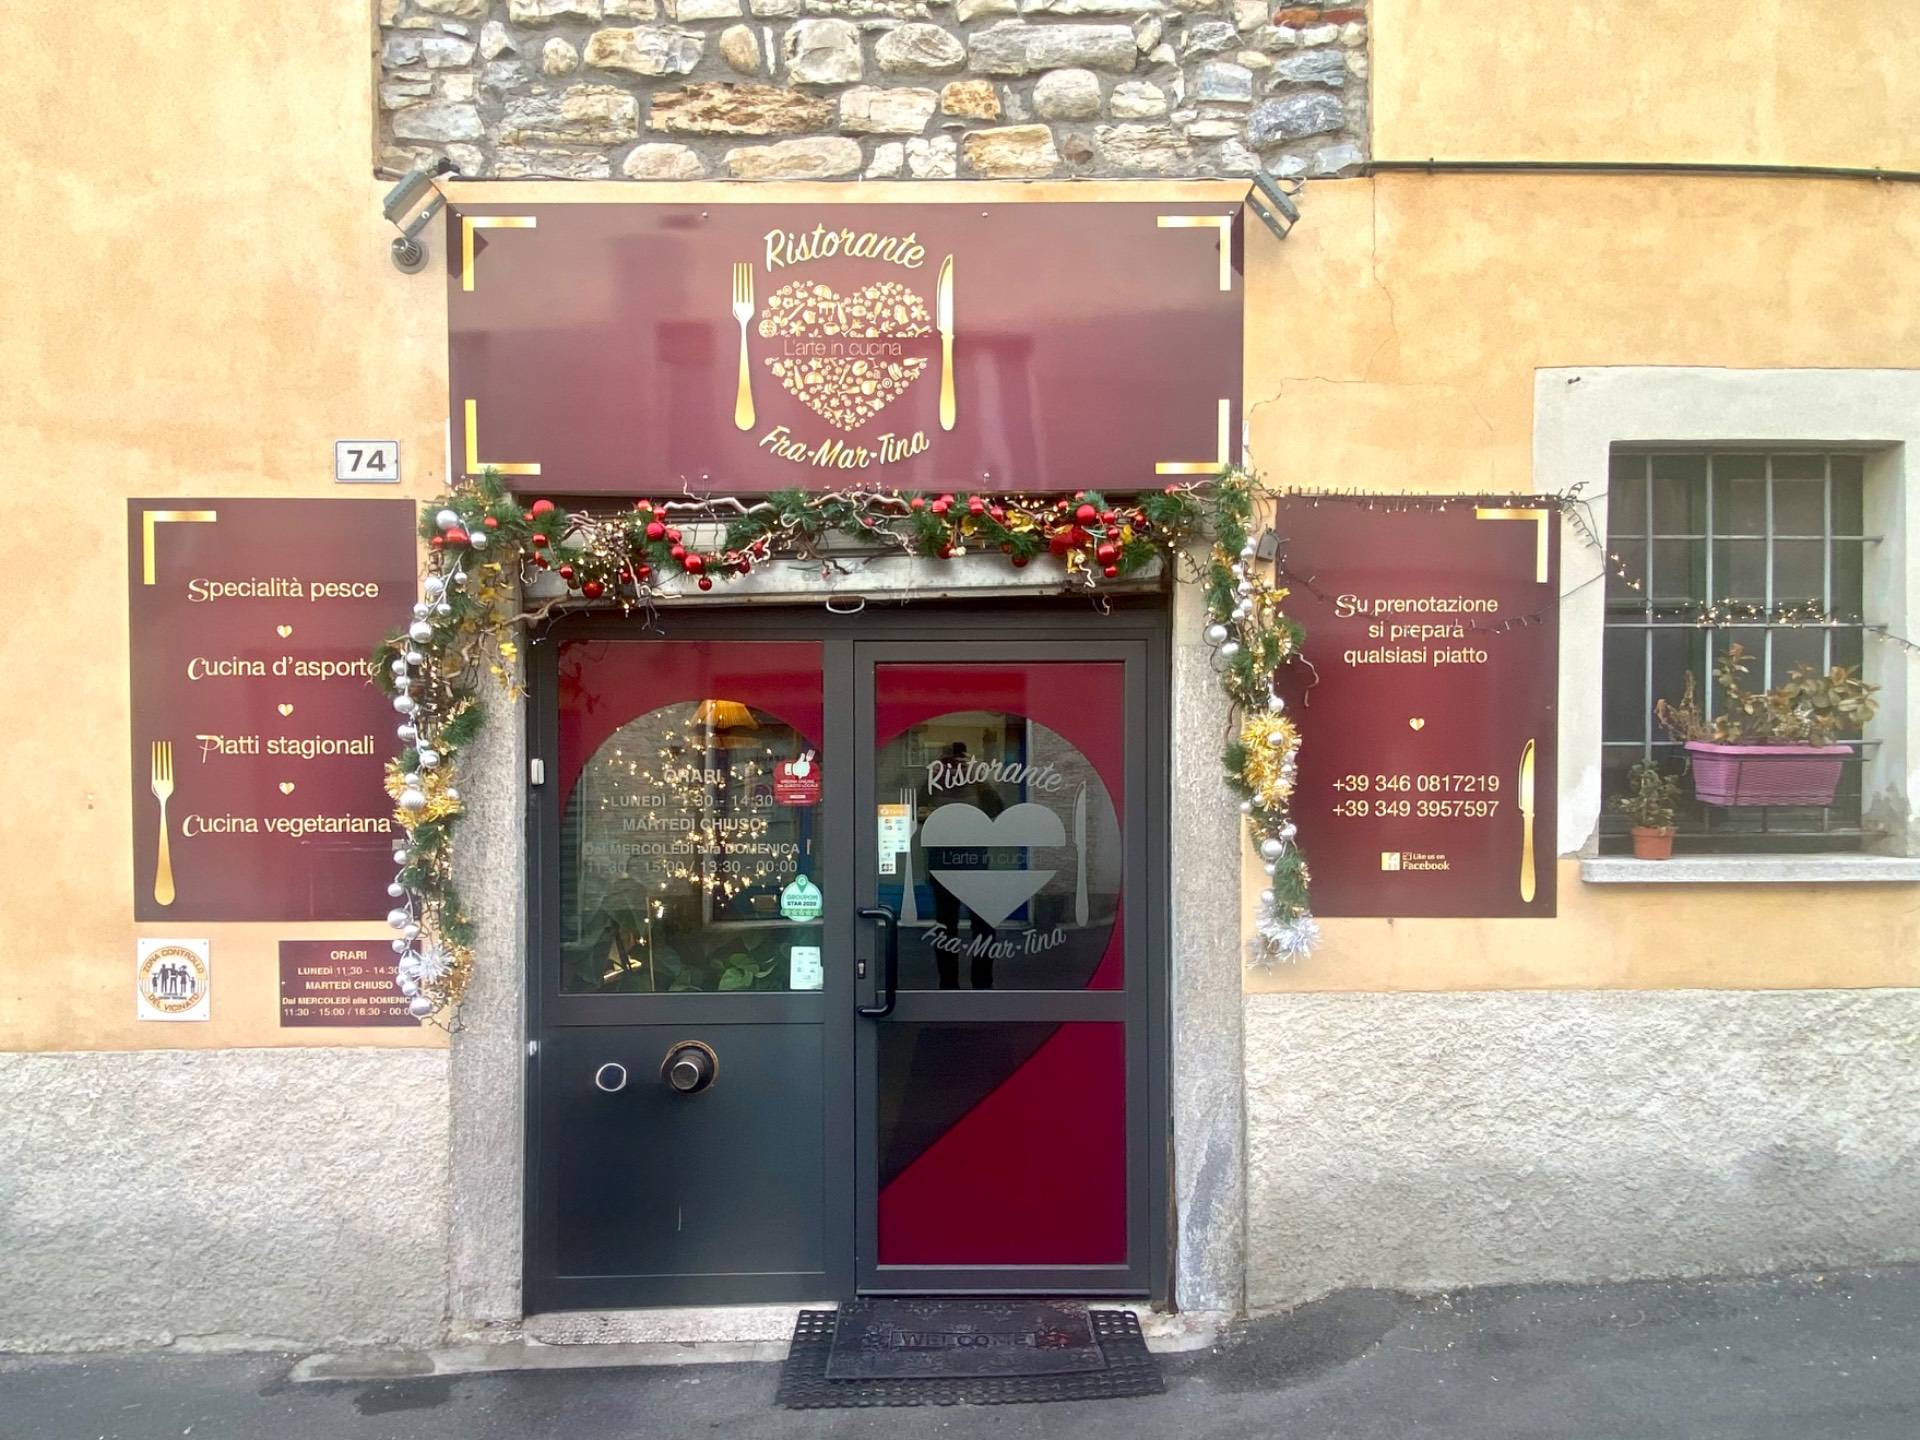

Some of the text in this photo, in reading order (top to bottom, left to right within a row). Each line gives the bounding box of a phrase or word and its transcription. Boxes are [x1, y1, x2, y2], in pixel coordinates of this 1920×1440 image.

[764, 223, 925, 272] Ristorante
[784, 340, 902, 356] L'arte in cucina
[347, 450, 386, 472] 74
[188, 577, 379, 602] Specialità pesce
[1335, 594, 1498, 618] Su prenotazione
[1369, 621, 1464, 642] si prepara
[1344, 647, 1488, 667] qualsiasi piatto
[187, 656, 266, 680] Cucina
[195, 734, 375, 763] Piatti stagionali
[926, 754, 1063, 795] Ristorante
[1332, 774, 1500, 792] +39 346 0817219
[732, 795, 773, 807] 14:30
[1332, 800, 1499, 817] +39 349 3957597
[182, 813, 392, 837] Cucina vegetariana
[700, 818, 761, 831] CHIUSO
[725, 843, 800, 854] DOMENICA
[756, 860, 798, 873] 00:00
[1403, 861, 1450, 870] Facebook
[161, 948, 204, 974] CONTROLLO
[330, 950, 368, 960] ORARI
[298, 966, 333, 975] LUNEDÌ
[305, 979, 393, 990] MARTEDÌ CHIUSO
[148, 992, 200, 1011] DEL VICINATO
[282, 997, 296, 1005] Dal
[369, 997, 411, 1005] DOMENIC
[389, 1008, 410, 1016] 00:0
